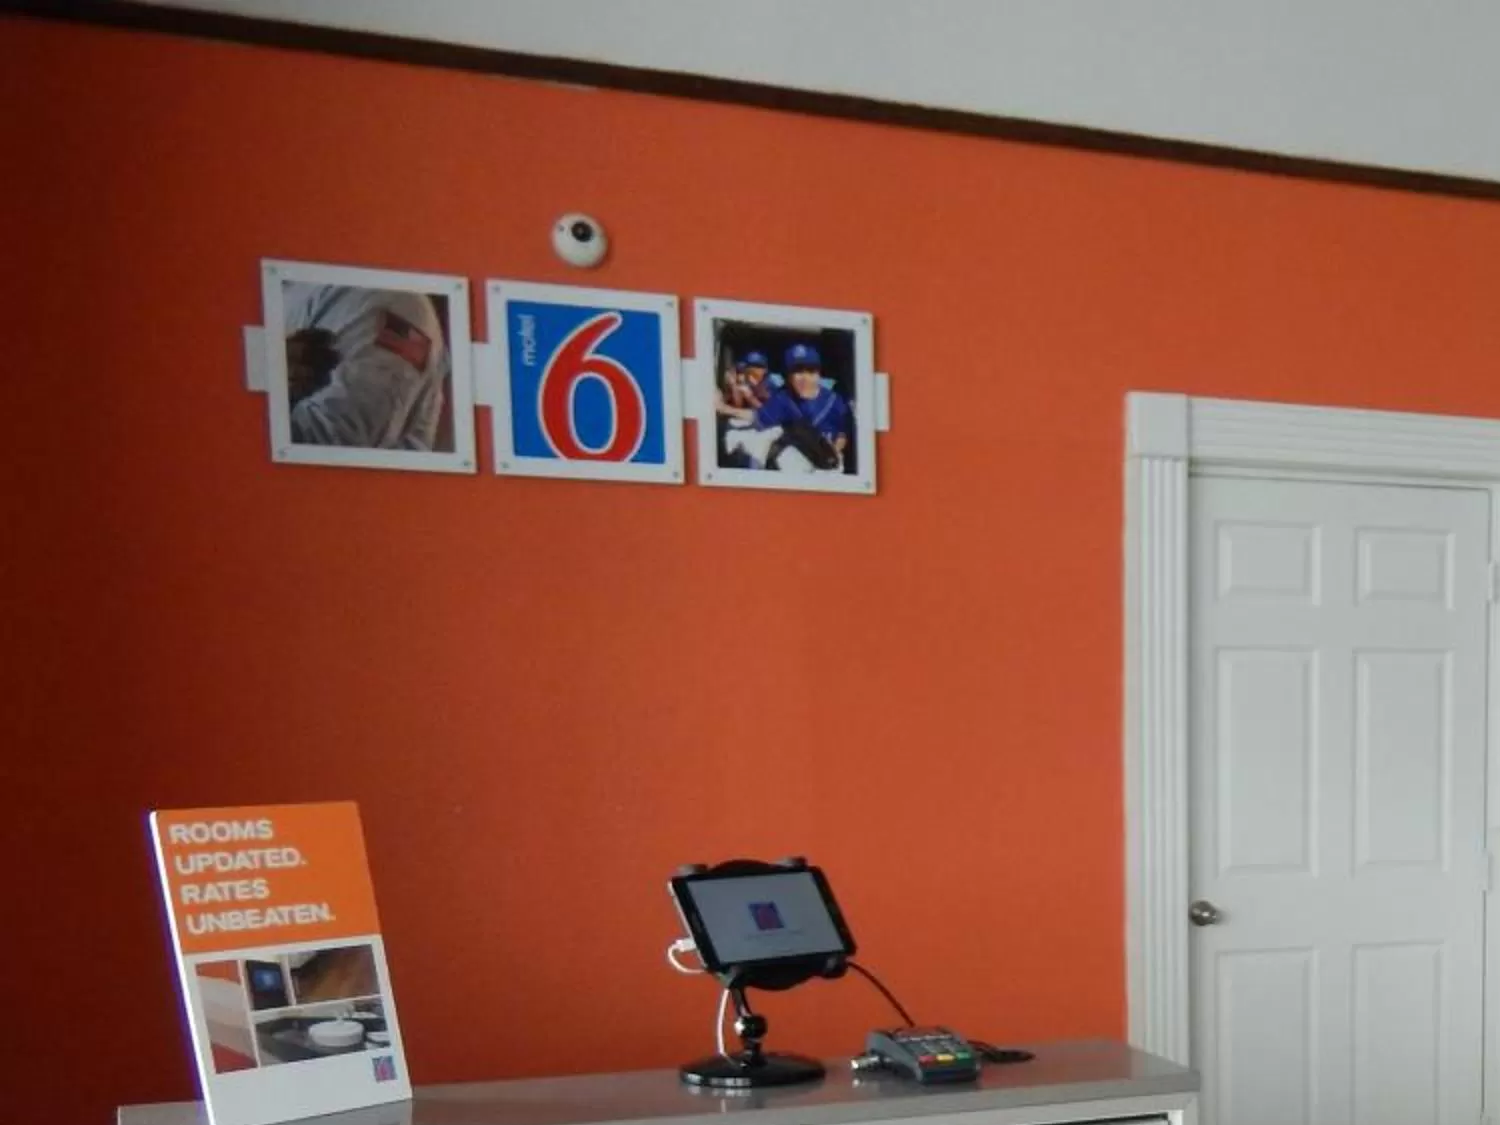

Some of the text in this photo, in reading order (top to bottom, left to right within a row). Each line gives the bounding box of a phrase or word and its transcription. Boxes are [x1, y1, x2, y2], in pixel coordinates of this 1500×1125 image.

[517, 314, 537, 366] motel
[538, 312, 646, 462] 6
[169, 819, 273, 845] ROOMS
[175, 848, 306, 875] UPDATED.
[180, 879, 270, 905] RATES
[185, 902, 336, 935] UNBEATEN.
